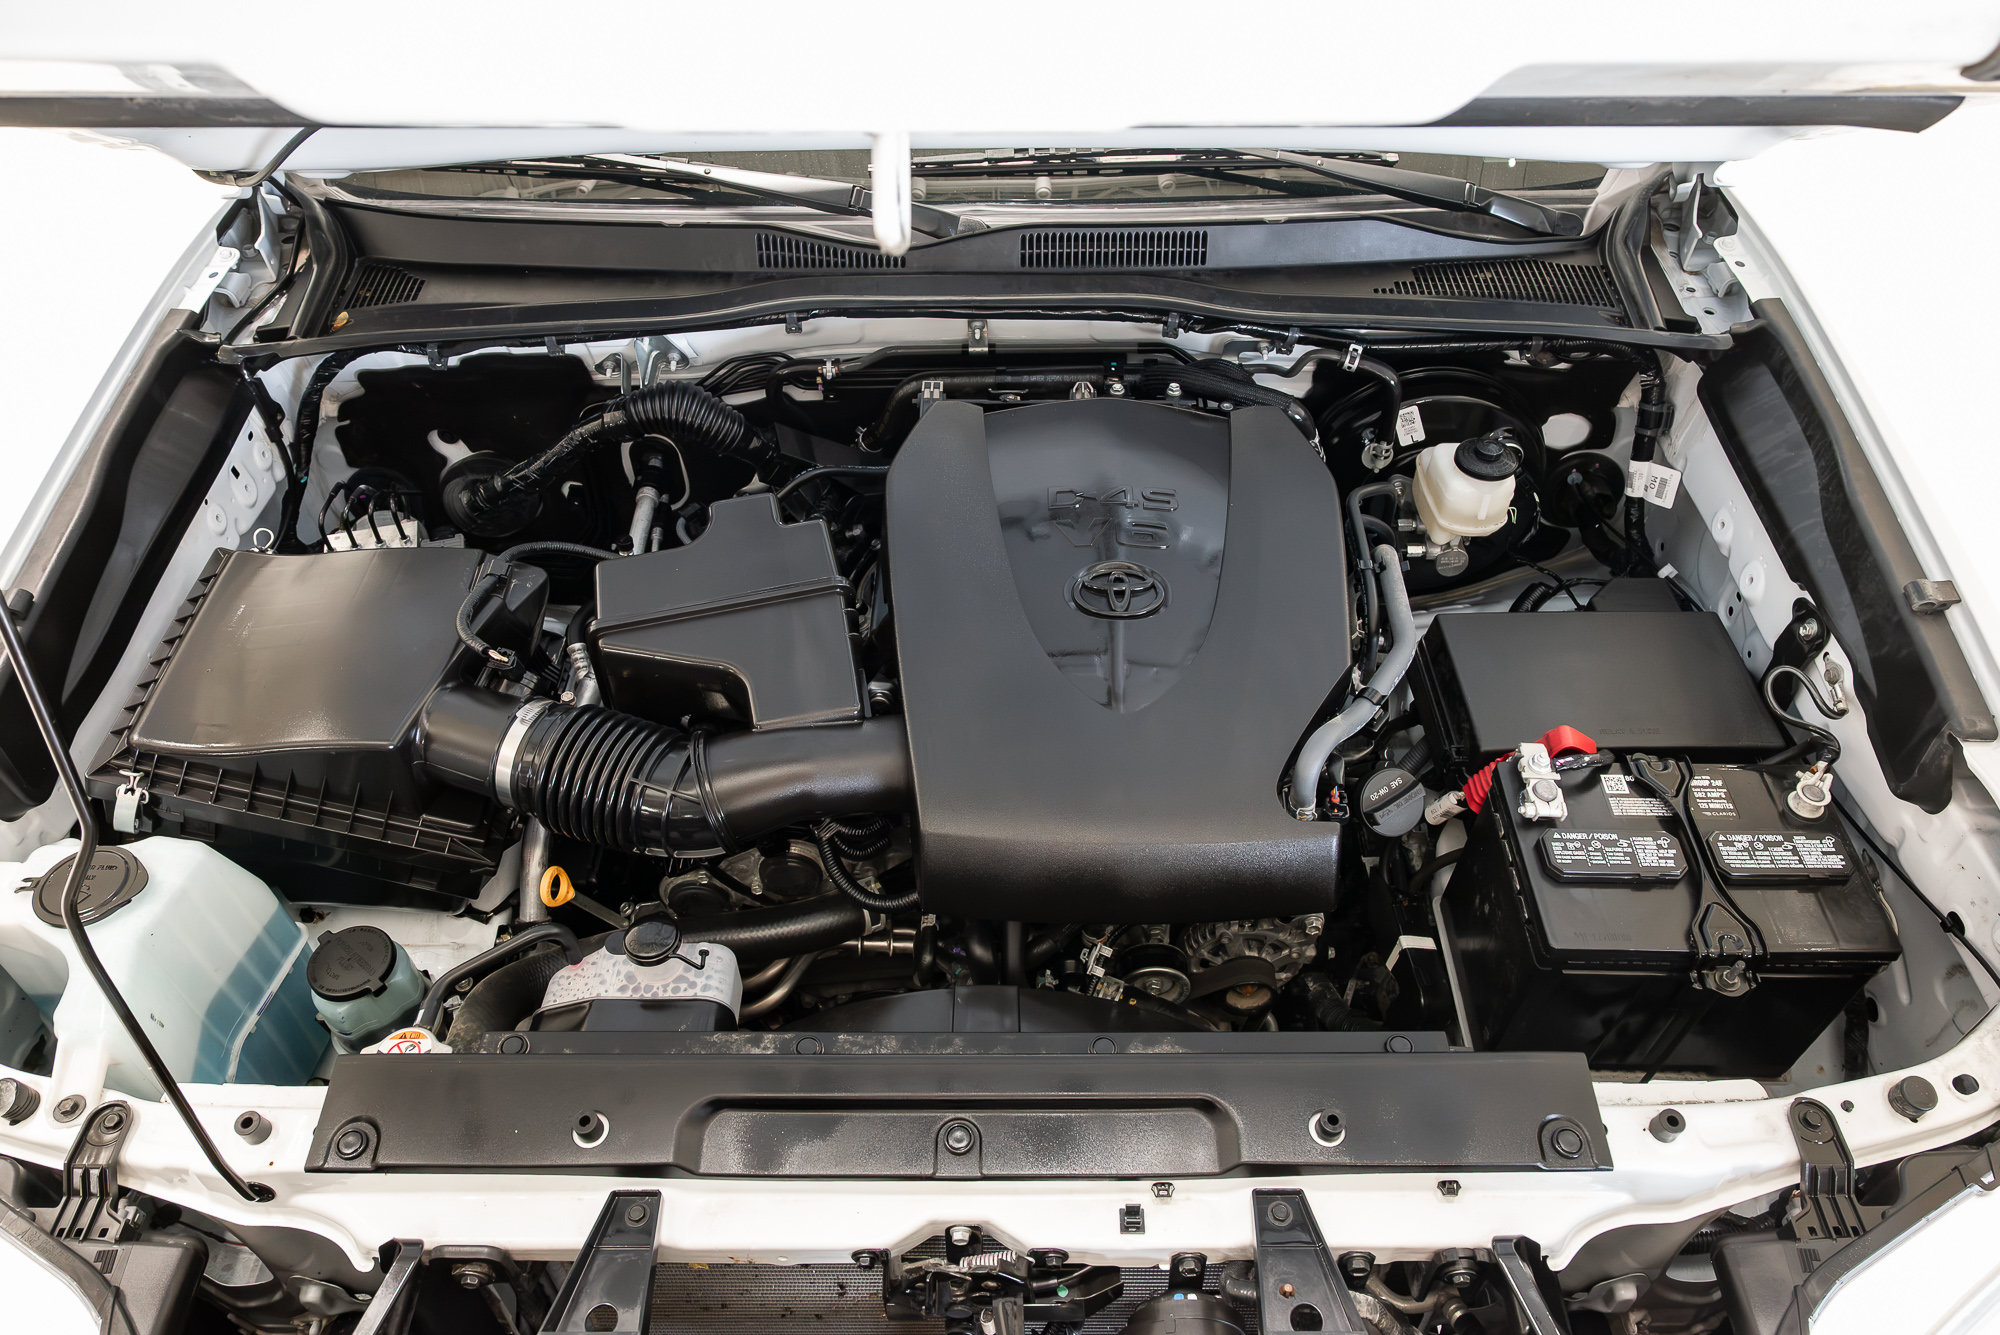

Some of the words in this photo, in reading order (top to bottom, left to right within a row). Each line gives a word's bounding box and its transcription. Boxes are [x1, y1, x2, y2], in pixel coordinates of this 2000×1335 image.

[1046, 485, 1180, 512] D-4S
[1055, 516, 1171, 550] V6
[1389, 777, 1403, 789] SAE
[1561, 832, 1589, 840] DANGER
